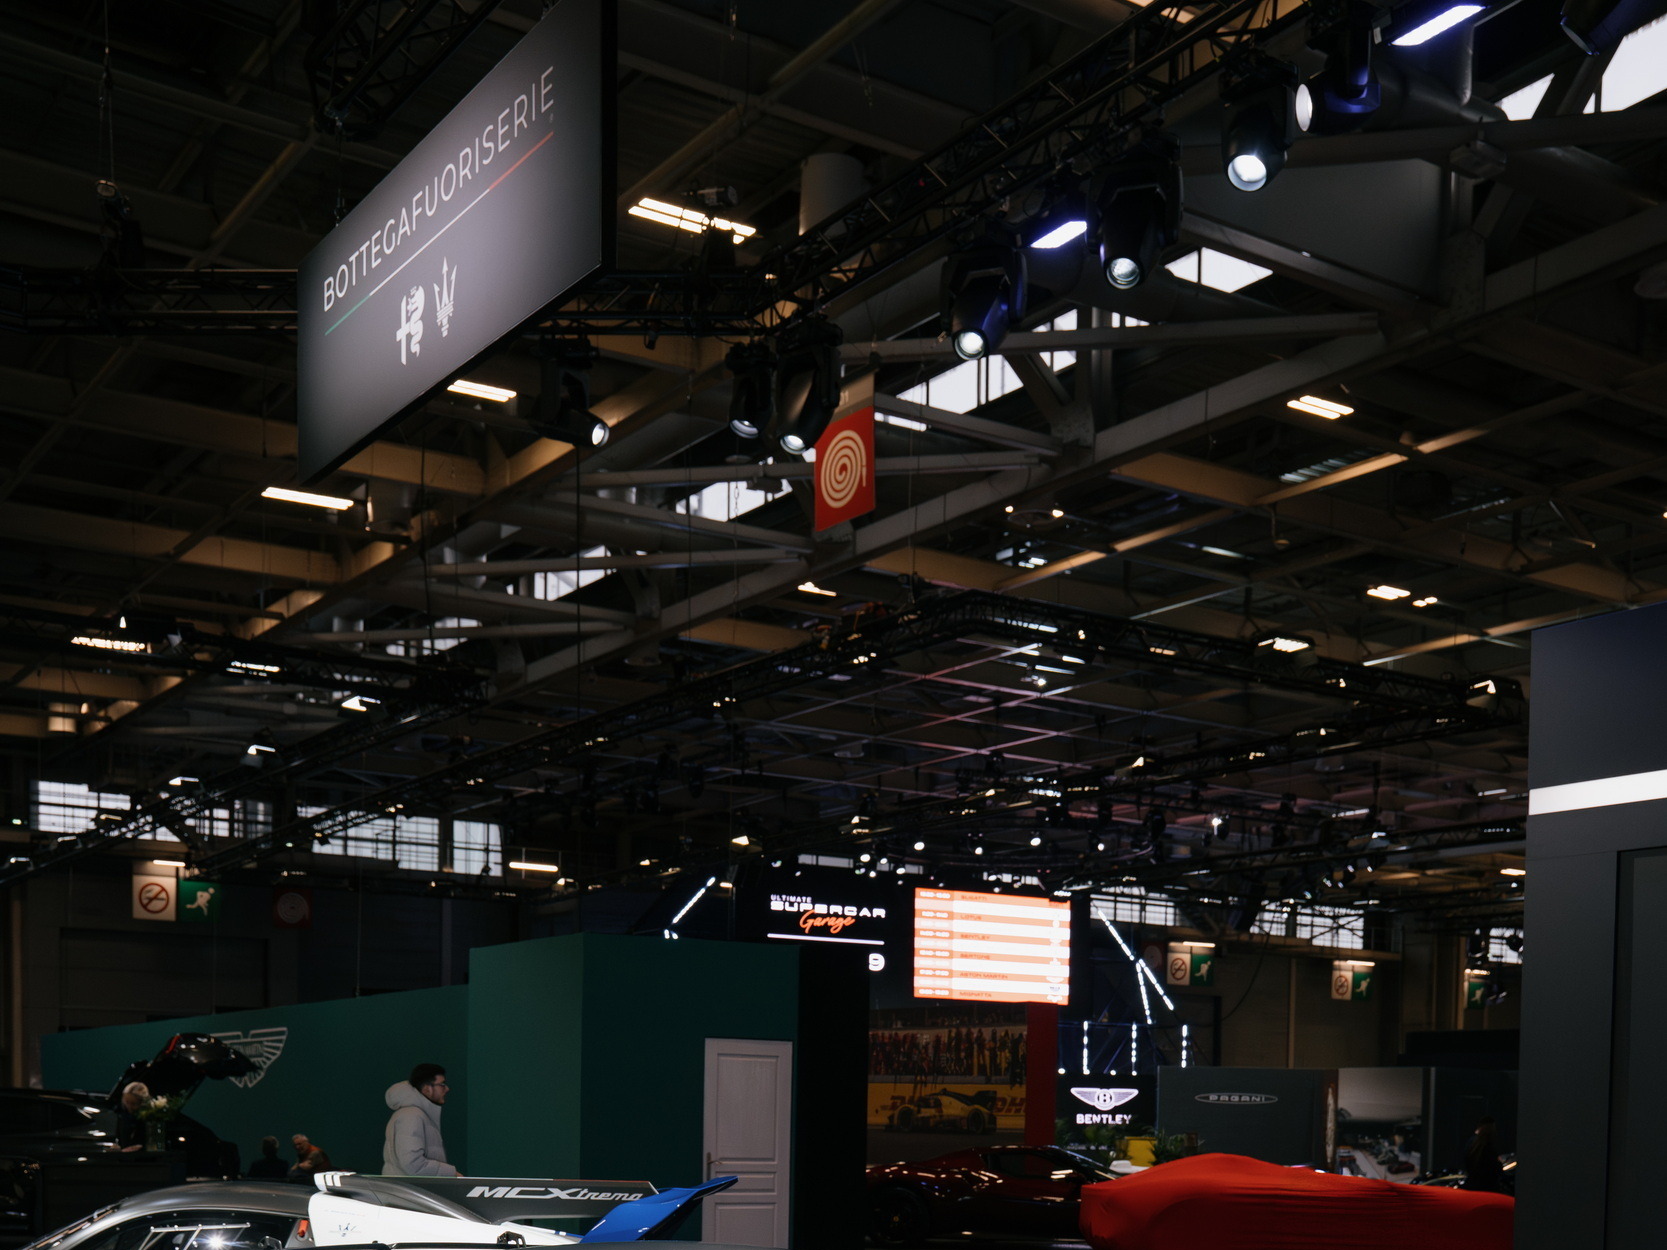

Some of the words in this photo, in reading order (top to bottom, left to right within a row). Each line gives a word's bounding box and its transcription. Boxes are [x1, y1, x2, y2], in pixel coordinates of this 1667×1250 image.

[323, 65, 554, 313] BOTTEGAFUORISERIE
[770, 893, 812, 903] ULTIMATE
[770, 900, 887, 918] SUPERCAR
[799, 909, 856, 934] Garage
[993, 1096, 1026, 1114] DH
[1208, 1094, 1266, 1102] PAGANI
[1076, 1113, 1132, 1125] BENTLEY
